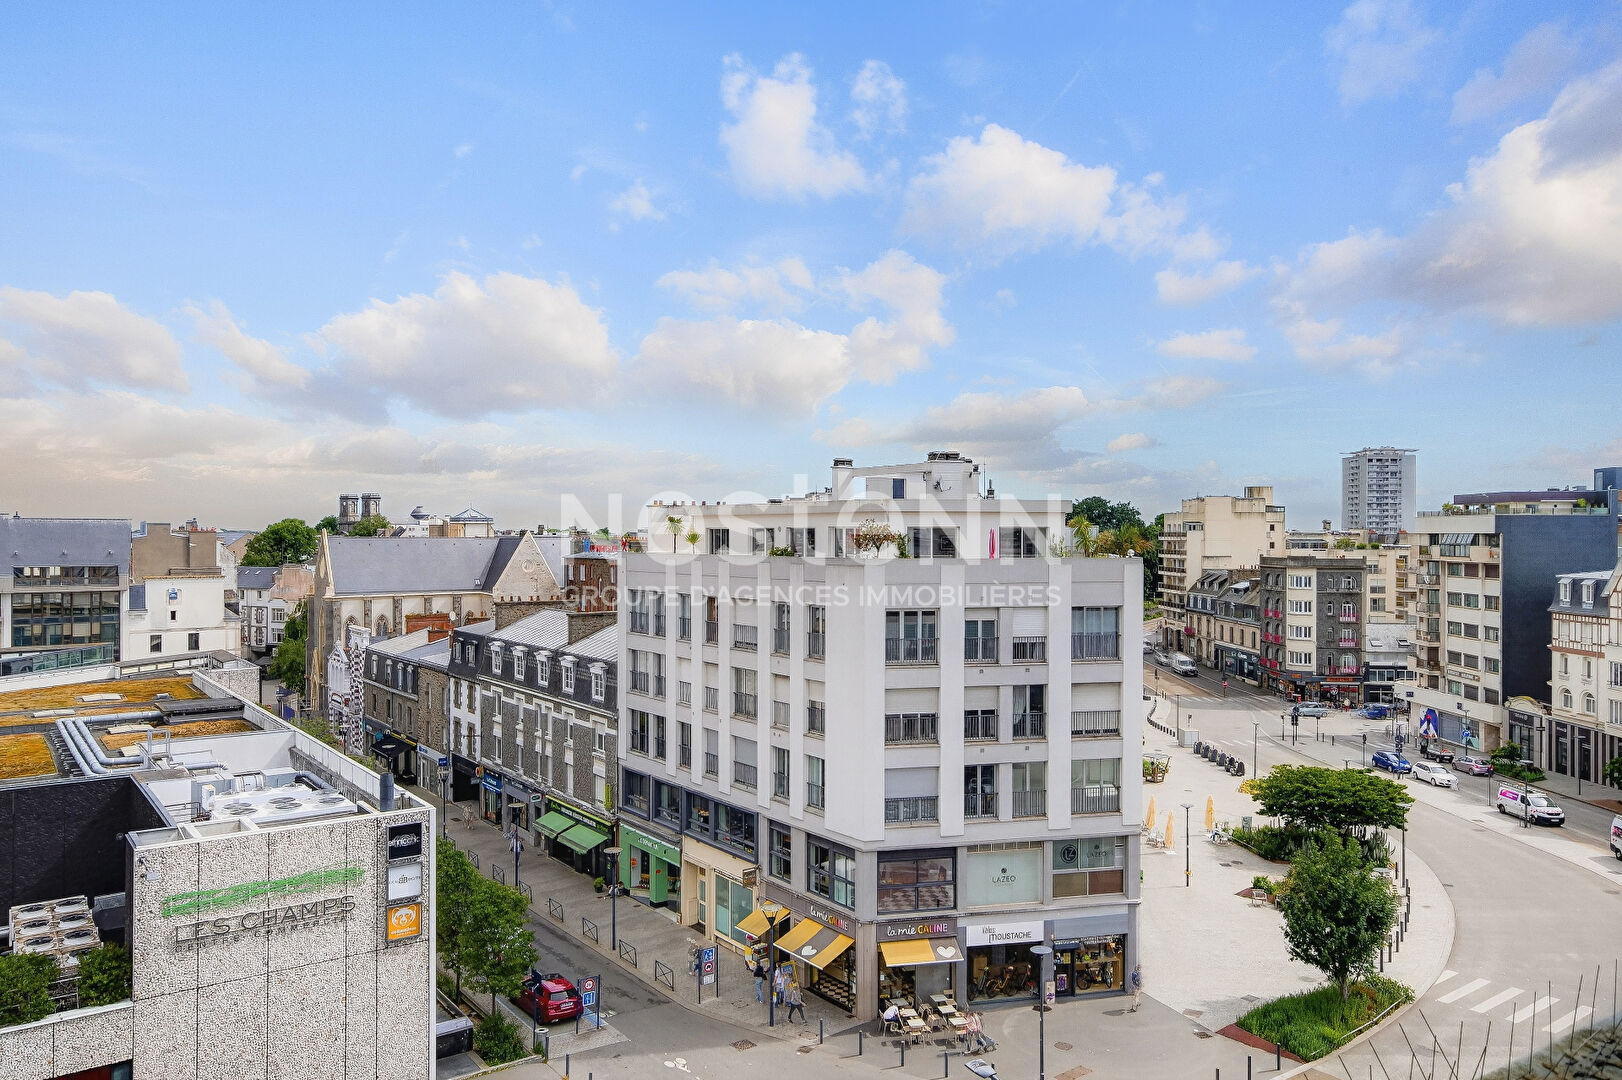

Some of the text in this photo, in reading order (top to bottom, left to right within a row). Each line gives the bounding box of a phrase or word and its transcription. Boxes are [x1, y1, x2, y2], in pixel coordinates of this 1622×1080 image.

[991, 875, 1017, 883] LAZEO
[175, 895, 356, 943] LES CHAMPS
[887, 925, 897, 936] la
[897, 925, 917, 936] mie
